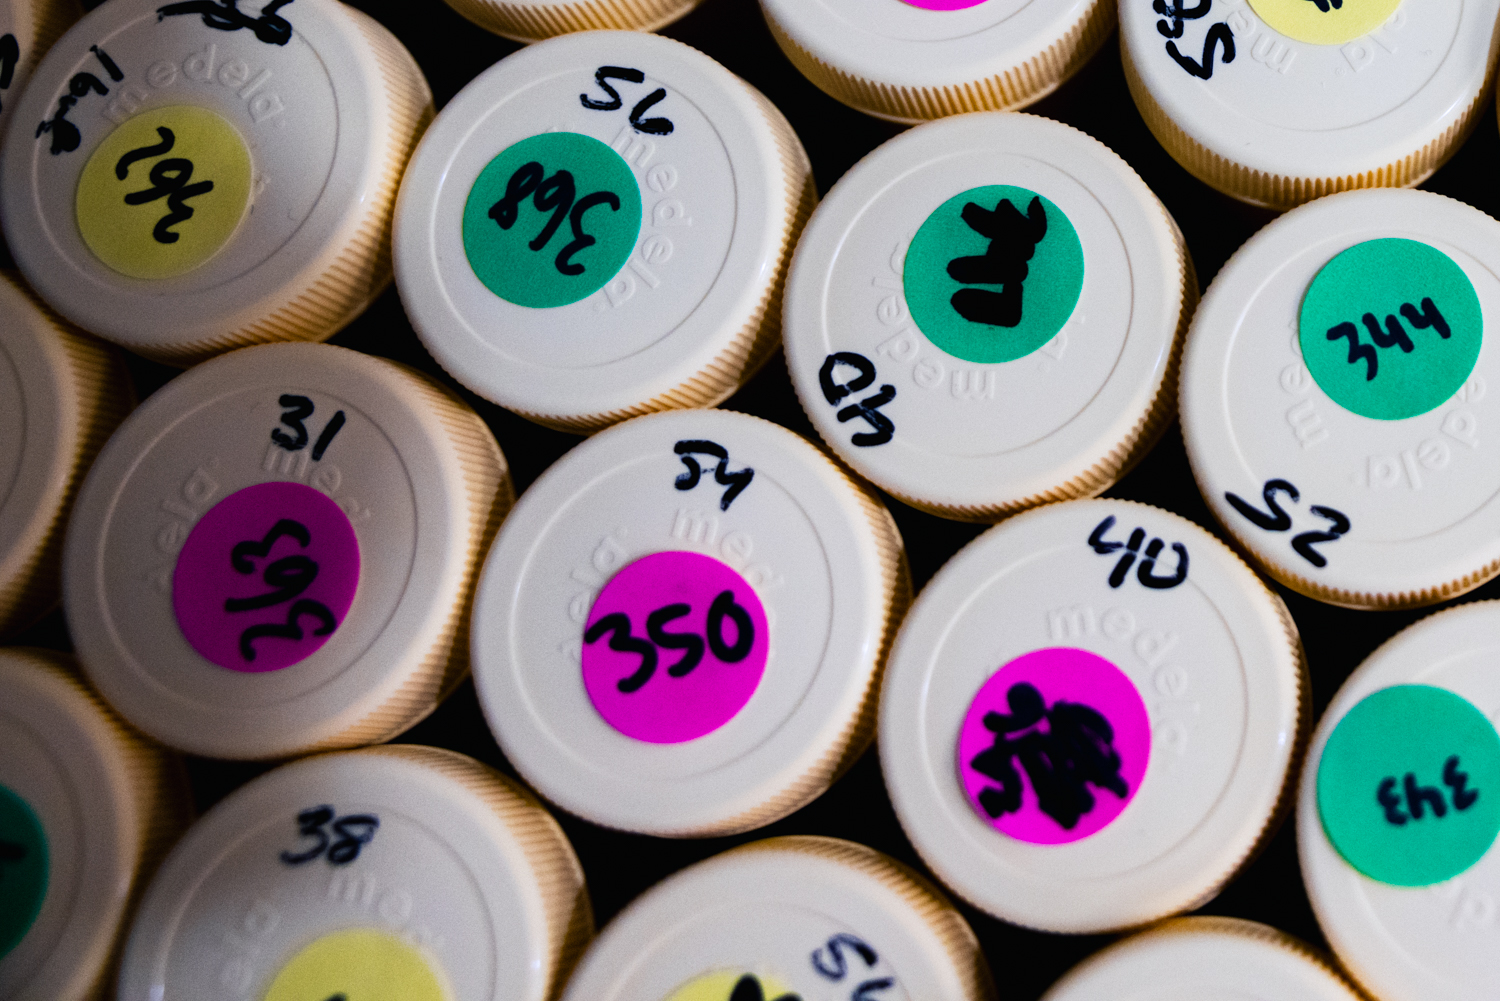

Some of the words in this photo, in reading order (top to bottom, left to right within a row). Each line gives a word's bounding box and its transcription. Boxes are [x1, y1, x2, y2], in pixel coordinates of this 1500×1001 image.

[488, 160, 621, 276] 368
[1325, 295, 1452, 385] 344
[271, 393, 346, 462] 31
[1224, 480, 1352, 568] 52
[225, 518, 337, 663] 363
[585, 590, 755, 694] 350
[281, 804, 380, 866] 38
[1375, 754, 1480, 828] 343
